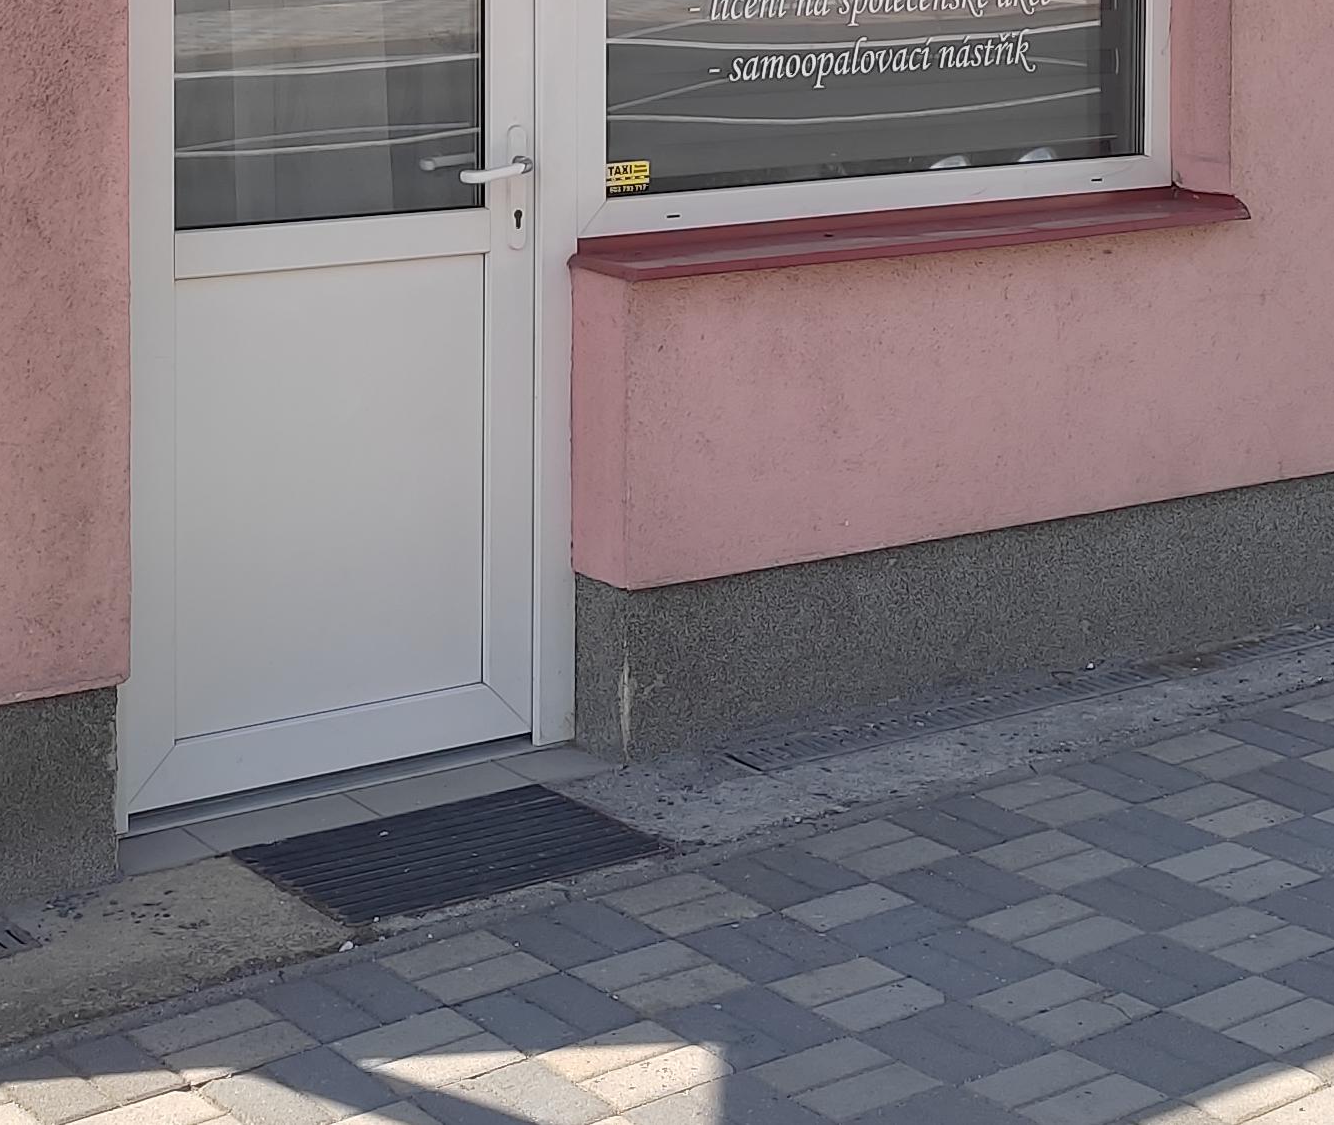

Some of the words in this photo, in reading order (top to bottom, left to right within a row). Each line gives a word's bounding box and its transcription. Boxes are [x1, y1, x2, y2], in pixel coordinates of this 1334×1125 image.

[729, 37, 931, 89] samoopalovací
[938, 29, 1036, 72] nástřik
[608, 165, 632, 176] TAXI
